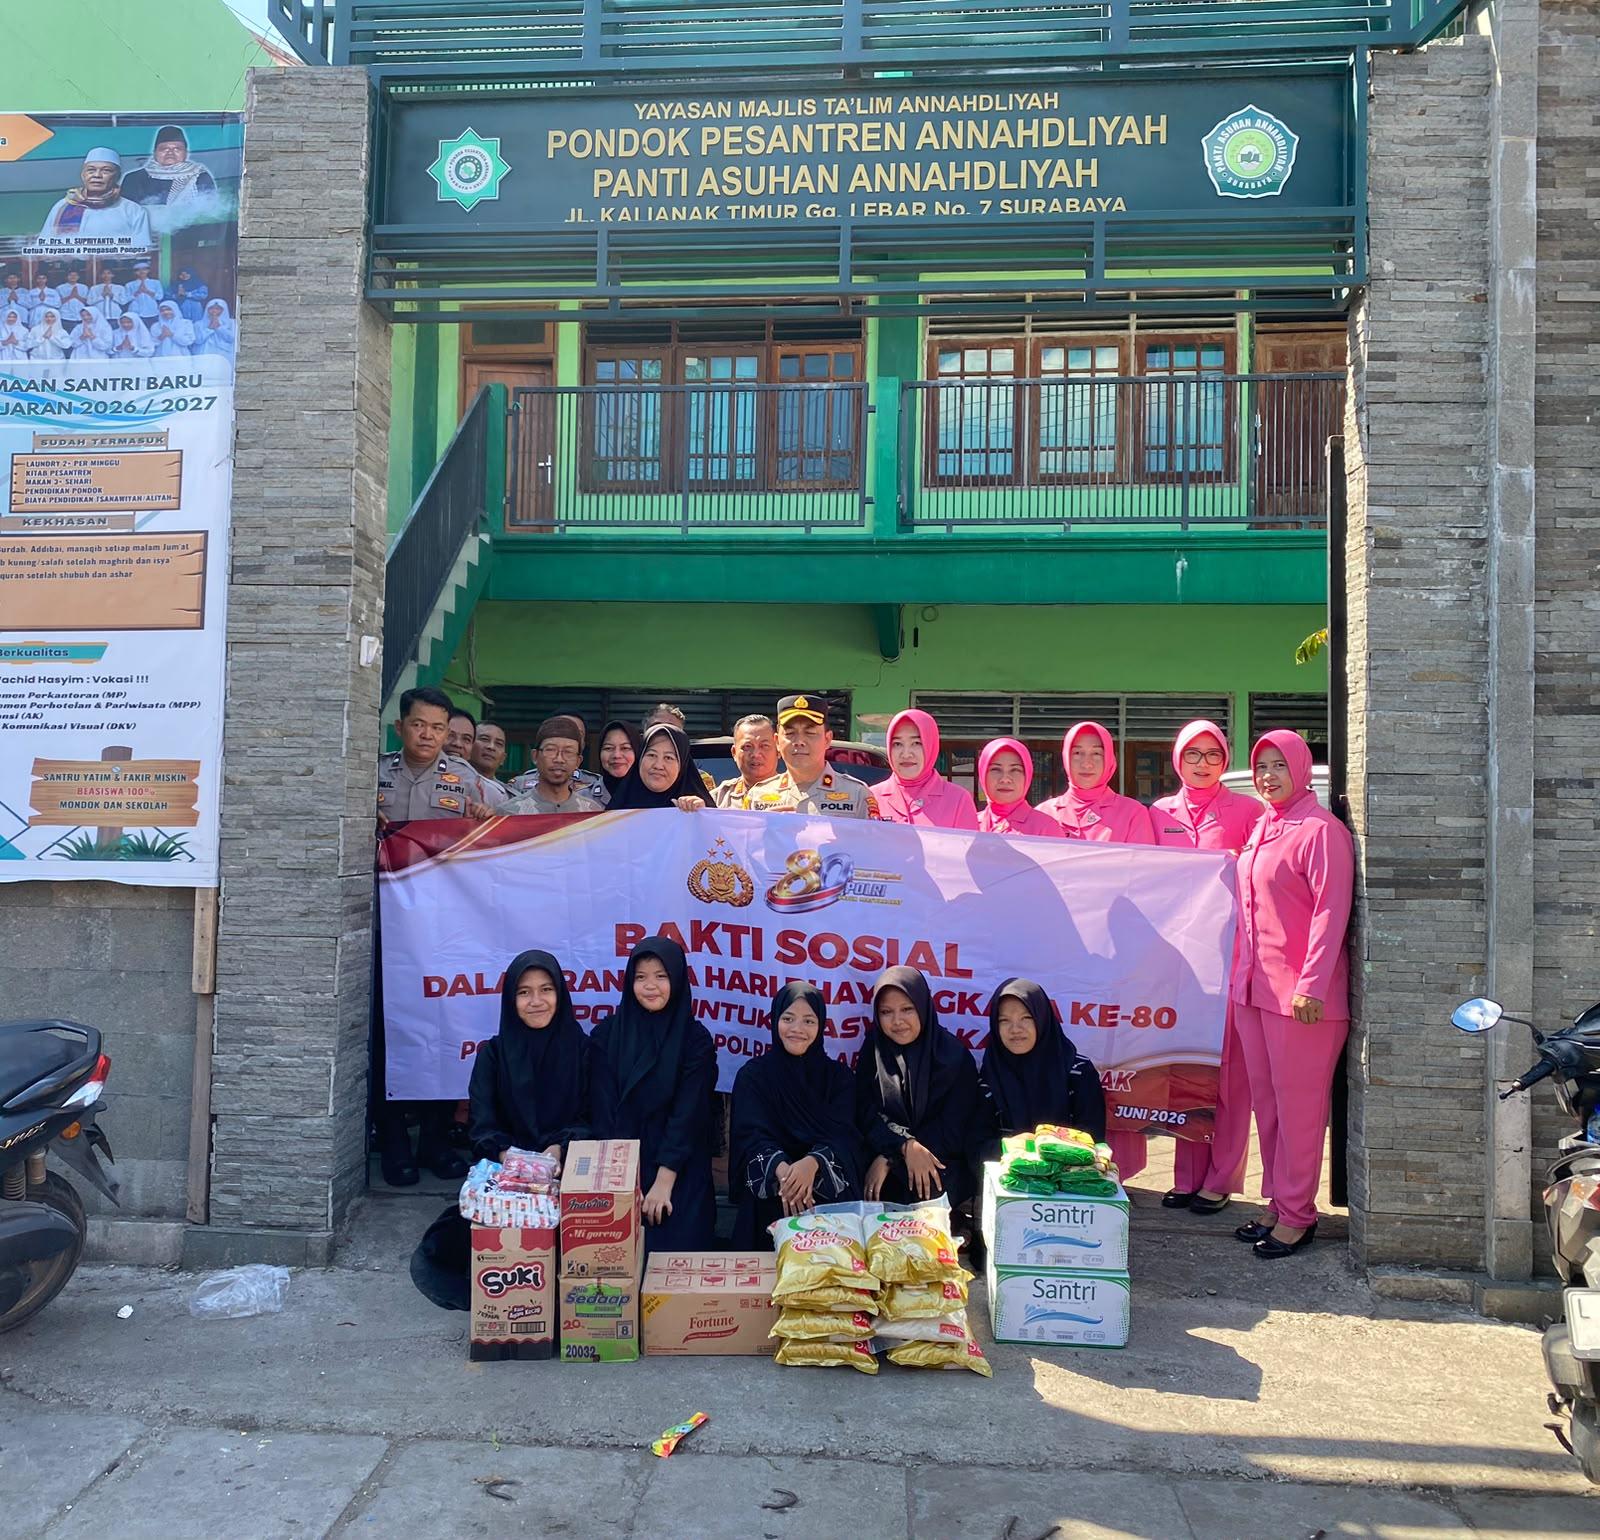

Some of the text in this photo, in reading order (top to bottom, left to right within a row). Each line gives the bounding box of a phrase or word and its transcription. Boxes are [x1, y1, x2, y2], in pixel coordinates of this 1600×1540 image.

[634, 101, 732, 120] YAYASAN
[738, 99, 817, 118] MAJLIS
[898, 92, 1060, 114] ANNAHDLIYAH
[1217, 118, 1252, 144] ASUHAN
[547, 115, 1168, 159] PONDOK PESANTREN ANNAHDLIYAH
[1212, 145, 1226, 173] PANTI
[593, 158, 1099, 198] PANTI ASUHAN ANNAHDLIYAH
[1226, 176, 1273, 189] SURABAYA
[565, 208, 595, 223] JL.
[727, 203, 799, 220] TIMUR
[934, 201, 971, 216] No.
[979, 200, 993, 215] 7
[999, 197, 1128, 215] SURABAYA
[45, 247, 74, 255] Yayasan
[82, 246, 119, 255] Pengasuh
[63, 377, 140, 392] SANTRI
[146, 374, 202, 390] BARU
[80, 399, 137, 415] 2026
[160, 396, 218, 412] 2027
[40, 436, 165, 447] SUDAH TERMASUK
[25, 460, 60, 468] LAUNDRY
[90, 459, 120, 467] MINGGU
[25, 469, 48, 477] KITAB
[25, 478, 52, 486] MAKAN
[24, 487, 70, 495] PENDIDIKAN
[24, 496, 47, 504] BIAYA
[22, 517, 108, 526] KEKHASAN
[132, 543, 161, 551] malam
[66, 557, 97, 566] setelah
[98, 557, 134, 567] maghrib
[135, 556, 151, 565] dan
[26, 571, 57, 579] setelah
[59, 571, 90, 579] shubuh
[91, 570, 107, 578] dan
[109, 570, 133, 578] ashar
[0, 675, 36, 684] achid
[38, 675, 84, 686] Hasyim
[92, 675, 134, 684] Vokasi
[136, 675, 149, 684] !!!
[27, 691, 100, 699] Perkantoran
[101, 690, 127, 699] (MP)
[104, 701, 166, 709] Pariwisata
[168, 700, 201, 709] (MPP)
[21, 712, 44, 720] (AK)
[1, 722, 137, 730] Komunikasi Visual (DKV)
[43, 773, 187, 783] SANTRU YATIM & FAKIR MISKIN
[77, 786, 156, 796] BEASISWA 100%
[435, 783, 465, 794] POLRI
[59, 801, 168, 810] MONDOK DAN SEKOLAH
[820, 803, 854, 811] POLRI
[843, 881, 888, 898] POLRI
[615, 919, 974, 979] BAKTI SOSIAL
[423, 972, 507, 998] DAL
[704, 965, 779, 999] HARI
[1070, 1001, 1178, 1030] KE-80
[1114, 1105, 1188, 1125] JUNI 2026
[1030, 1202, 1095, 1225] Santri
[573, 1229, 623, 1240] Mi goreng
[1032, 1278, 1096, 1301] Santri
[565, 1291, 631, 1306] Sedaap
[562, 1319, 581, 1330] 20
[689, 1316, 735, 1329] Fortune
[621, 1325, 629, 1336] 8
[565, 1344, 596, 1359] 20032
